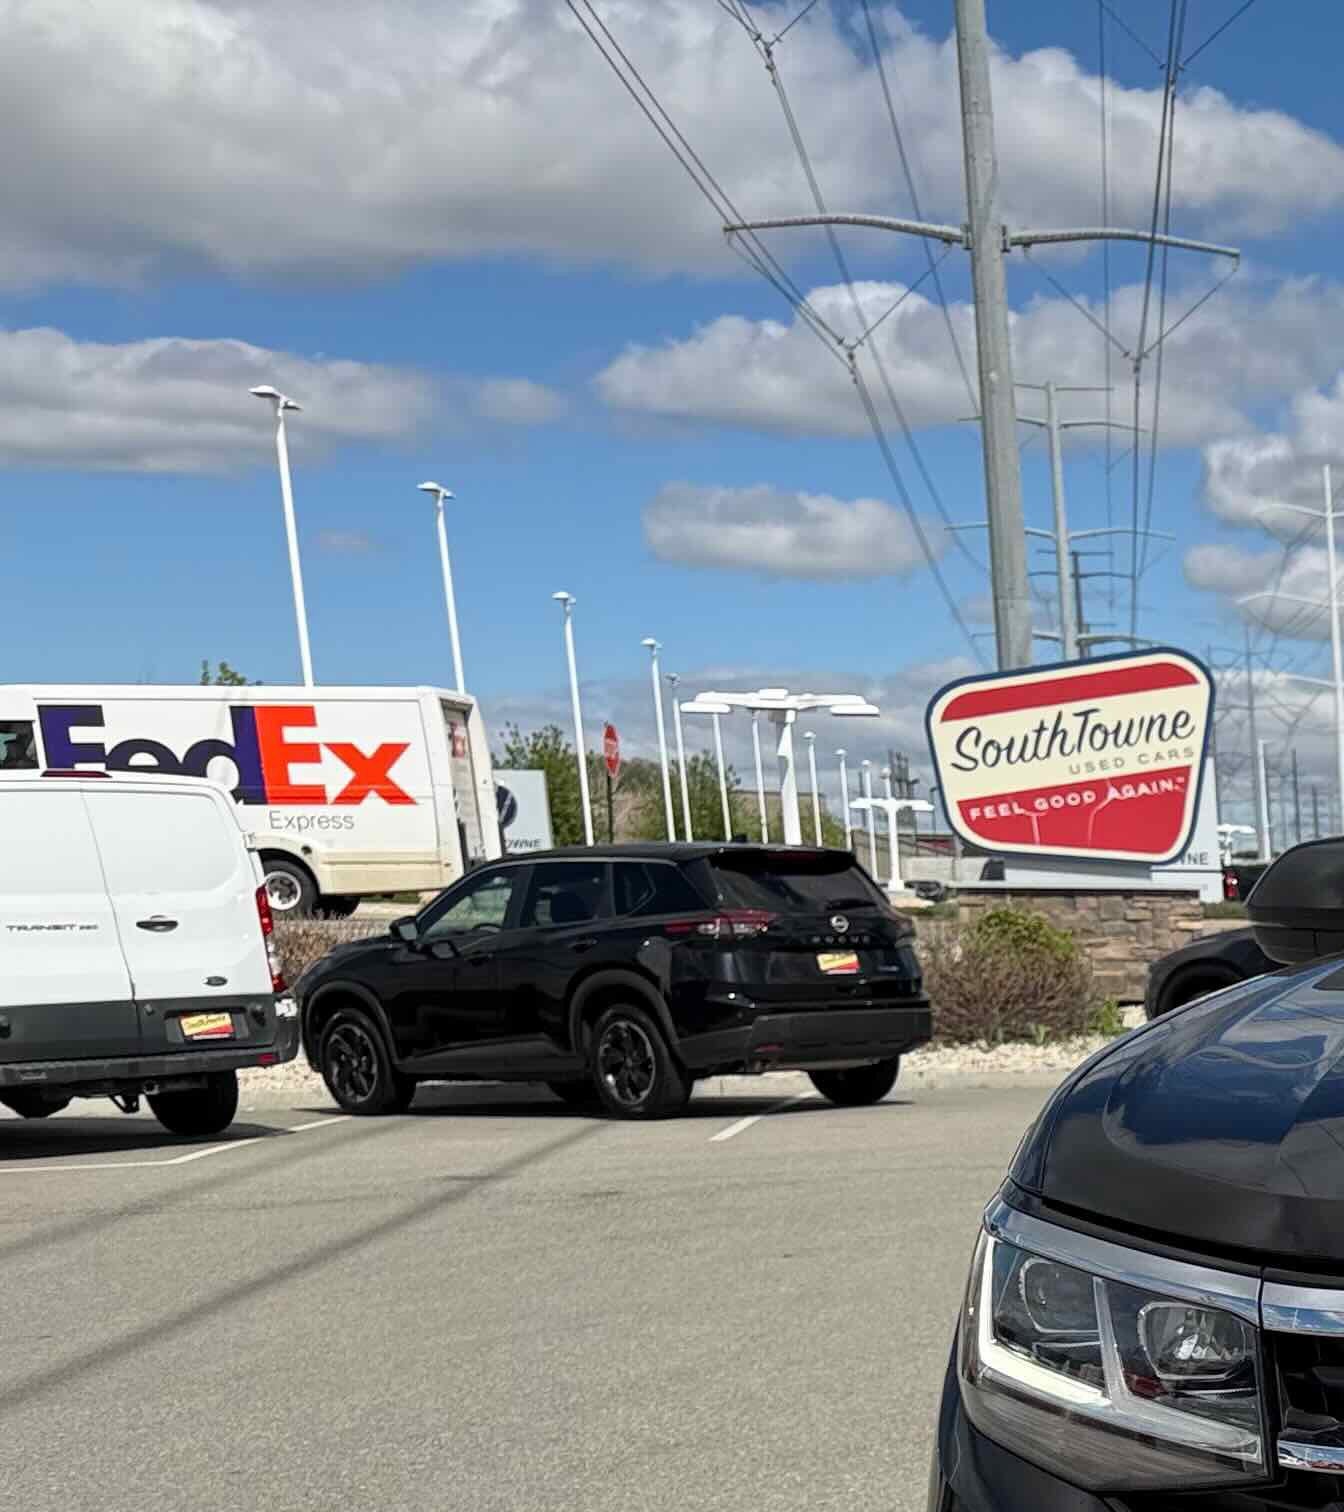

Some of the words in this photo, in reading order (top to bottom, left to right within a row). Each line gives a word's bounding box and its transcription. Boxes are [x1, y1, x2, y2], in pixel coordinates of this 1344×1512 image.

[1069, 757, 1126, 775] USED
[1137, 747, 1195, 764] CARS
[969, 801, 1025, 821] FEEL
[1034, 790, 1096, 811] GOOD
[268, 810, 355, 833] Express
